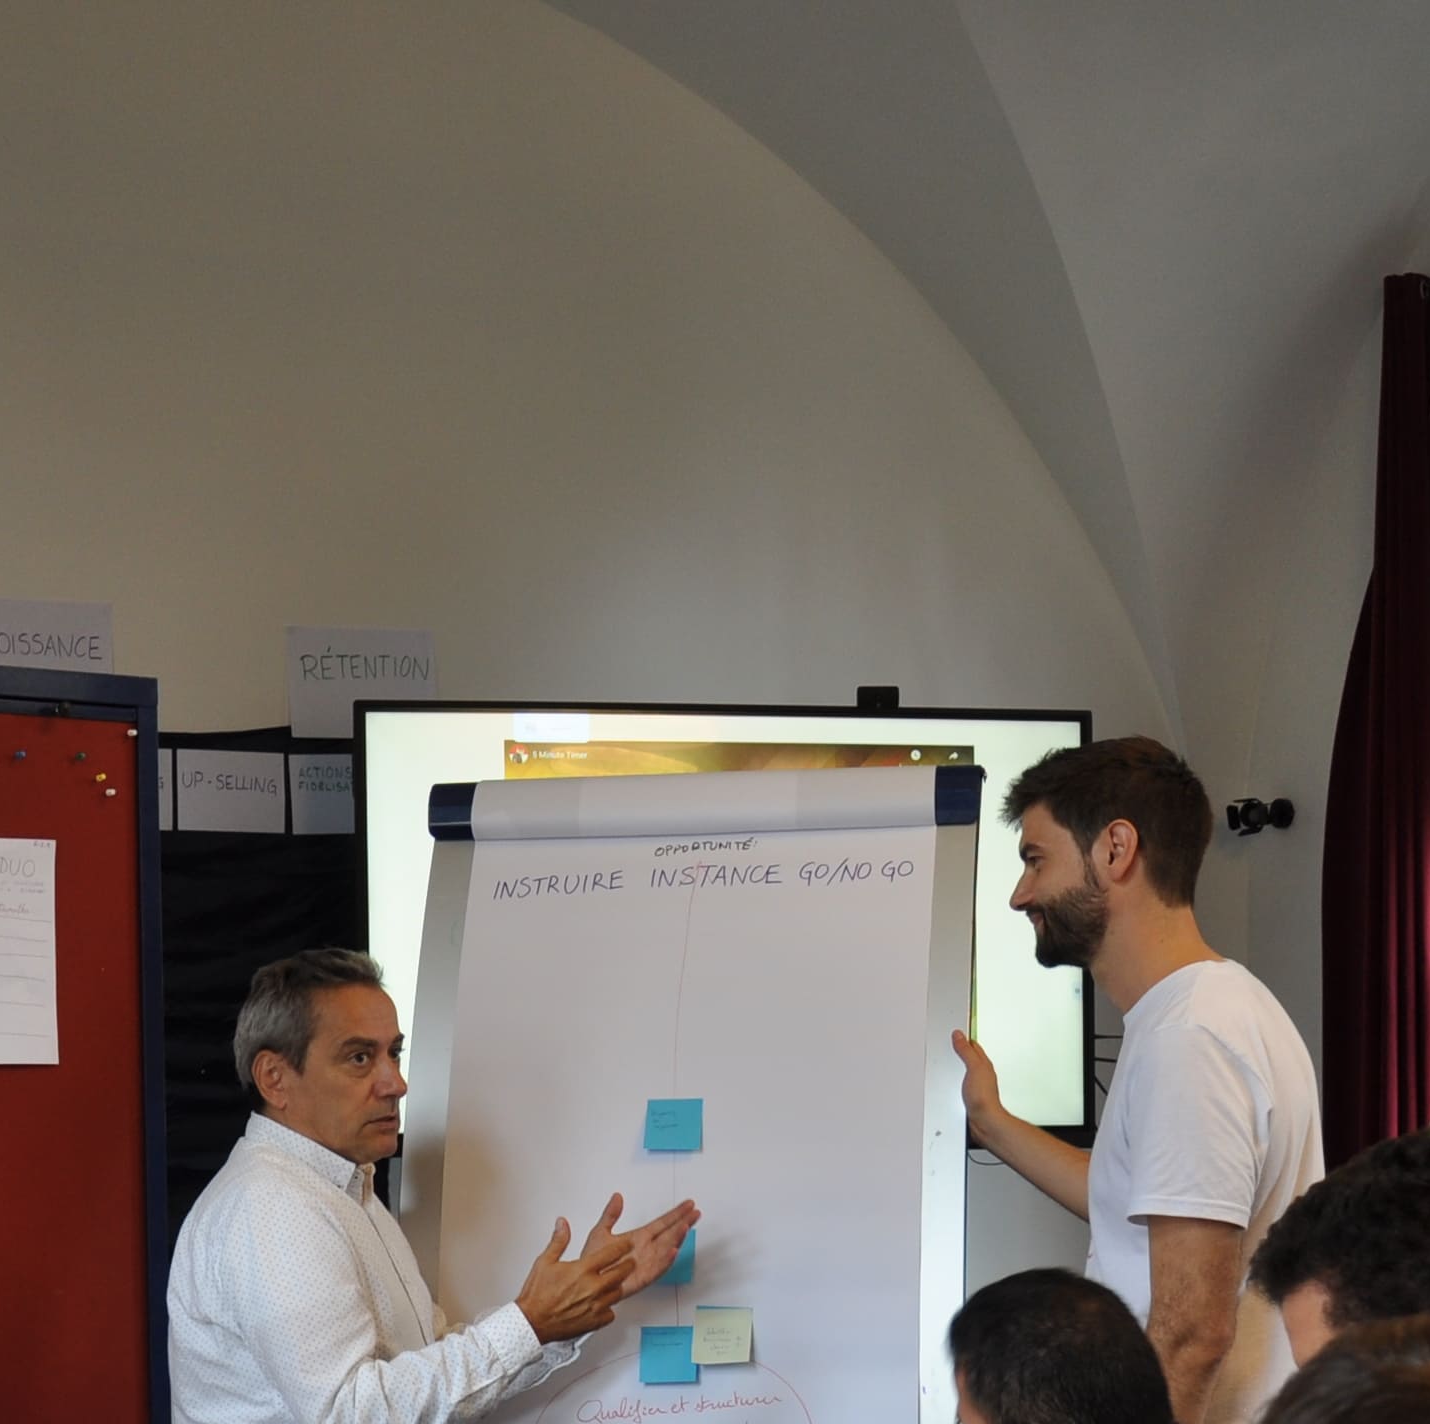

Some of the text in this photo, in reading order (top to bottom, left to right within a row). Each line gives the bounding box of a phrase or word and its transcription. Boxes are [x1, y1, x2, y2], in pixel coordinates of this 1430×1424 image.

[299, 645, 430, 681] RÉTENTION
[492, 869, 624, 900] INSTRUIRE
[650, 863, 783, 889] INSTANCE
[881, 859, 914, 882] GO
[576, 1397, 669, 1424] Qualifier
[671, 1397, 687, 1416] et
